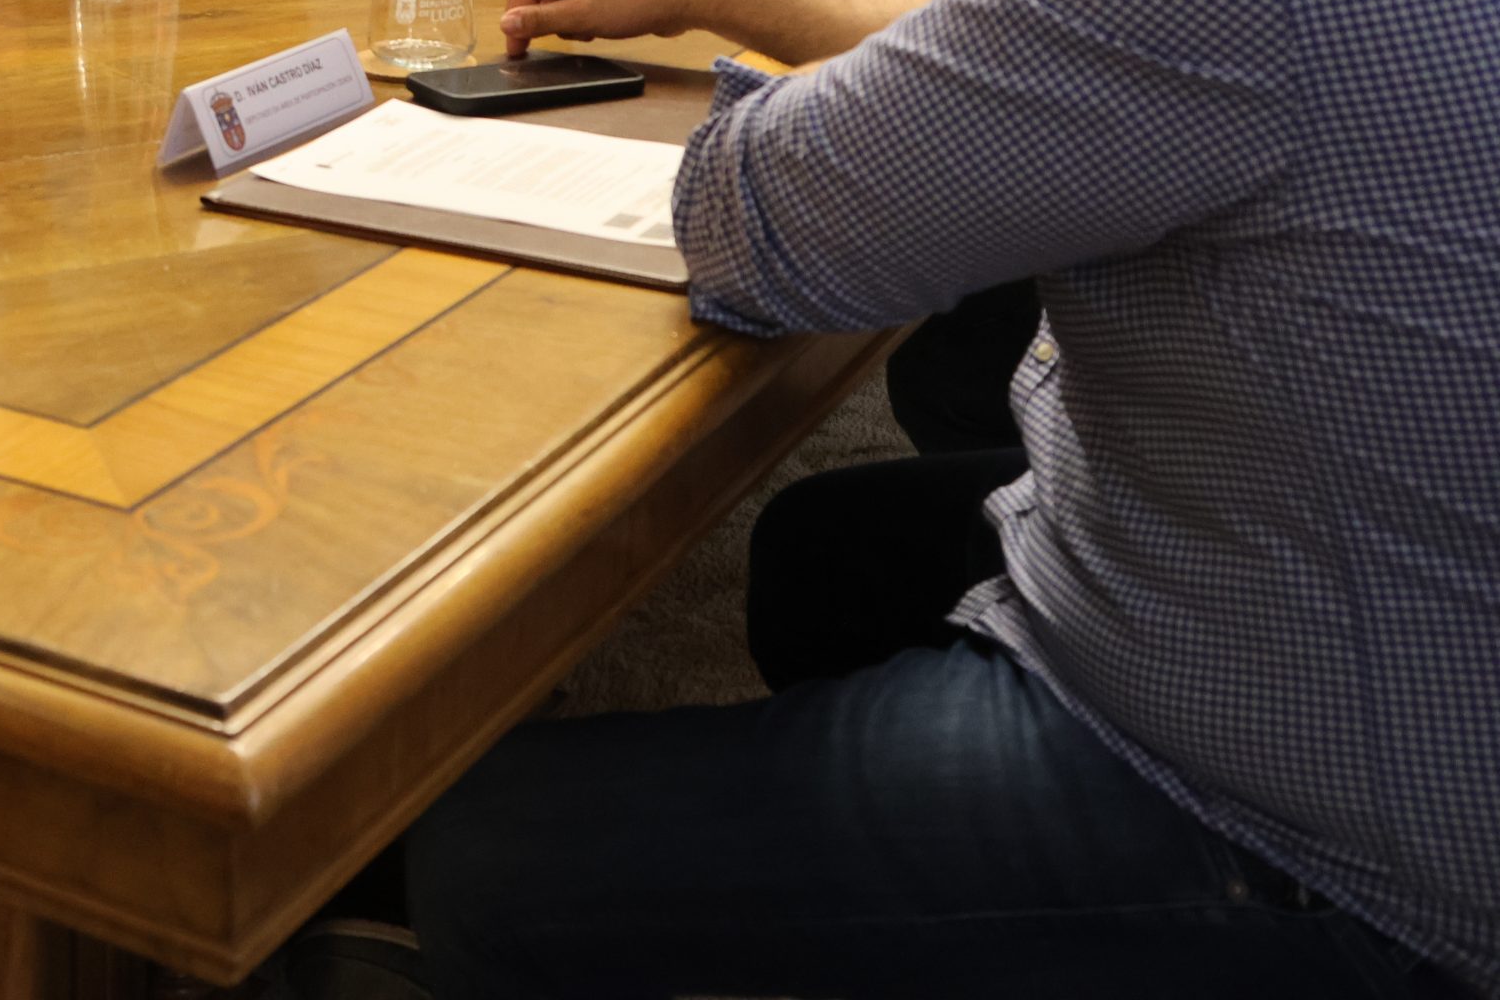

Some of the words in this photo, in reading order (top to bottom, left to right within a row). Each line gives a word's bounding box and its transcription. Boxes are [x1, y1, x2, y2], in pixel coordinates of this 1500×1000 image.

[431, 6, 465, 22] LUGO
[248, 78, 268, 96] IVÁN
[268, 66, 303, 89] CASTRO
[303, 57, 324, 76] DÍAZ
